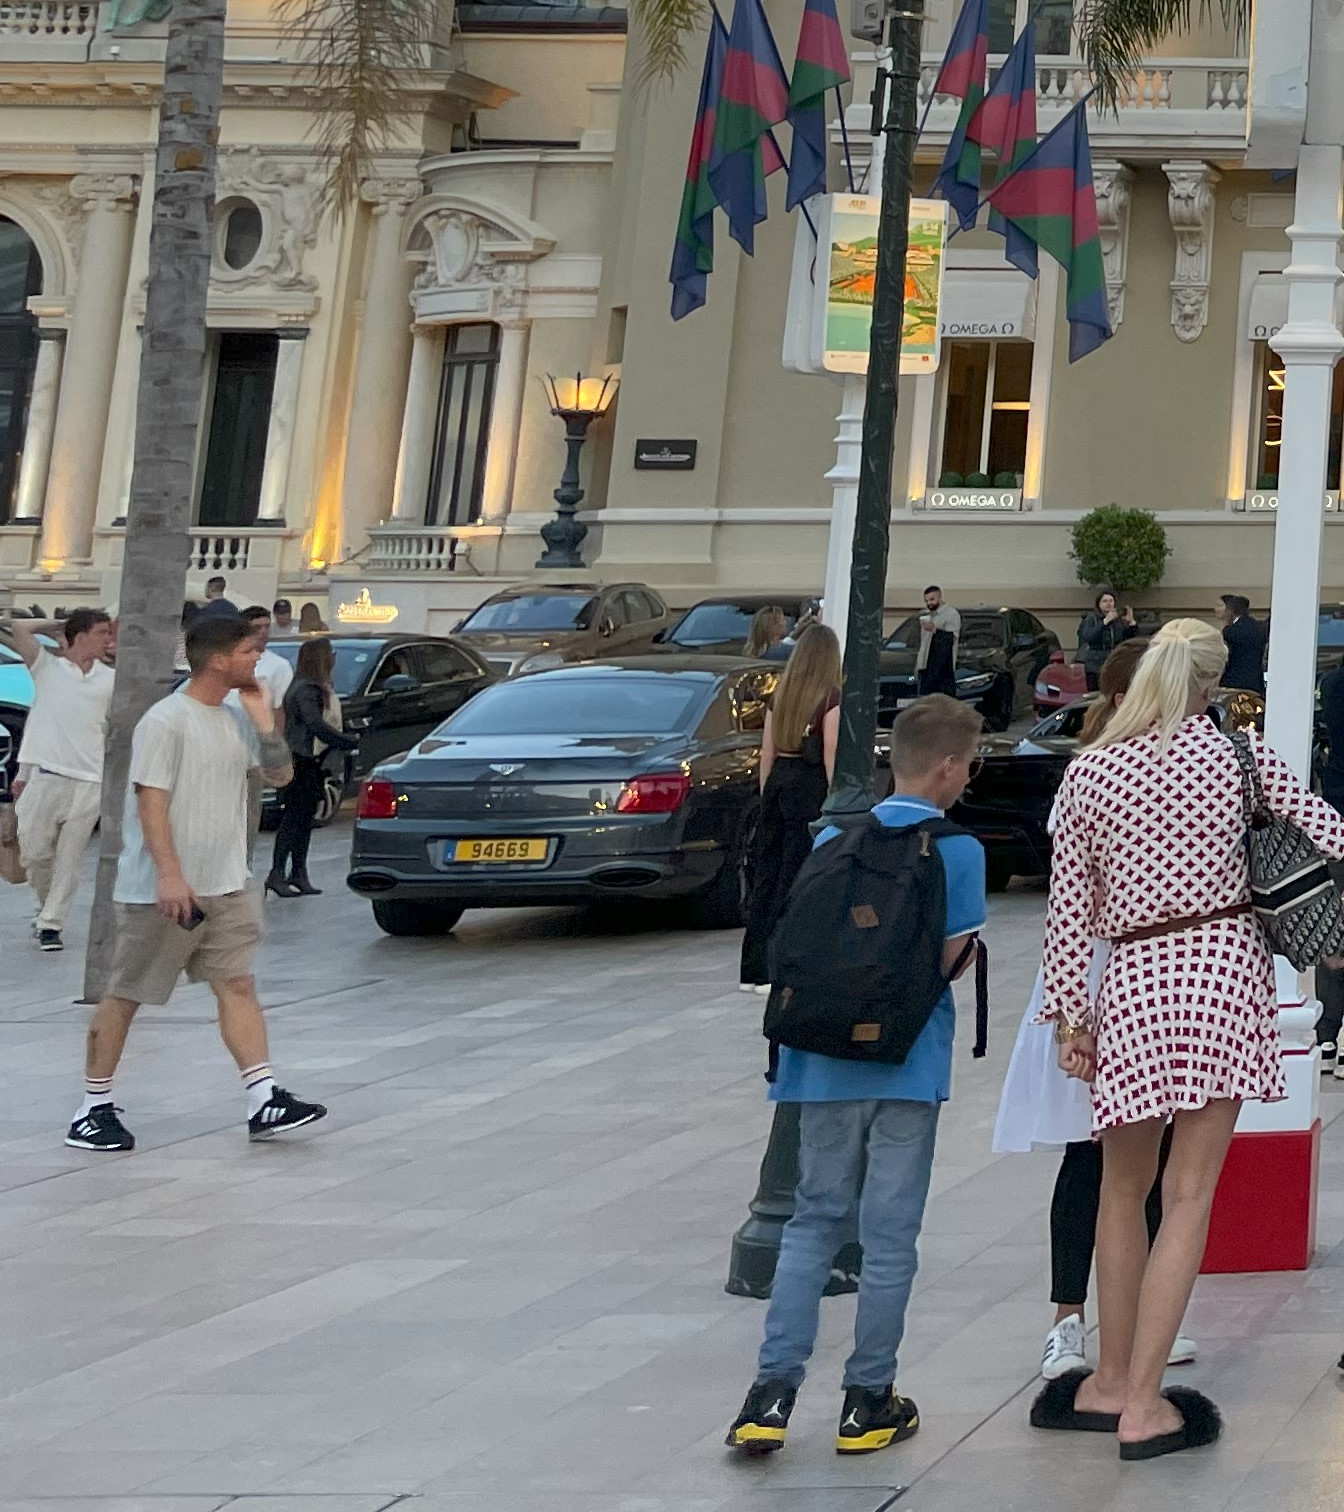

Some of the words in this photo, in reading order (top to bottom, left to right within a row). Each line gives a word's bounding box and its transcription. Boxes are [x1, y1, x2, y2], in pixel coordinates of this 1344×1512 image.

[949, 324, 997, 334] OMEGA
[948, 494, 997, 506] OMEGA
[472, 842, 530, 858] 94669
